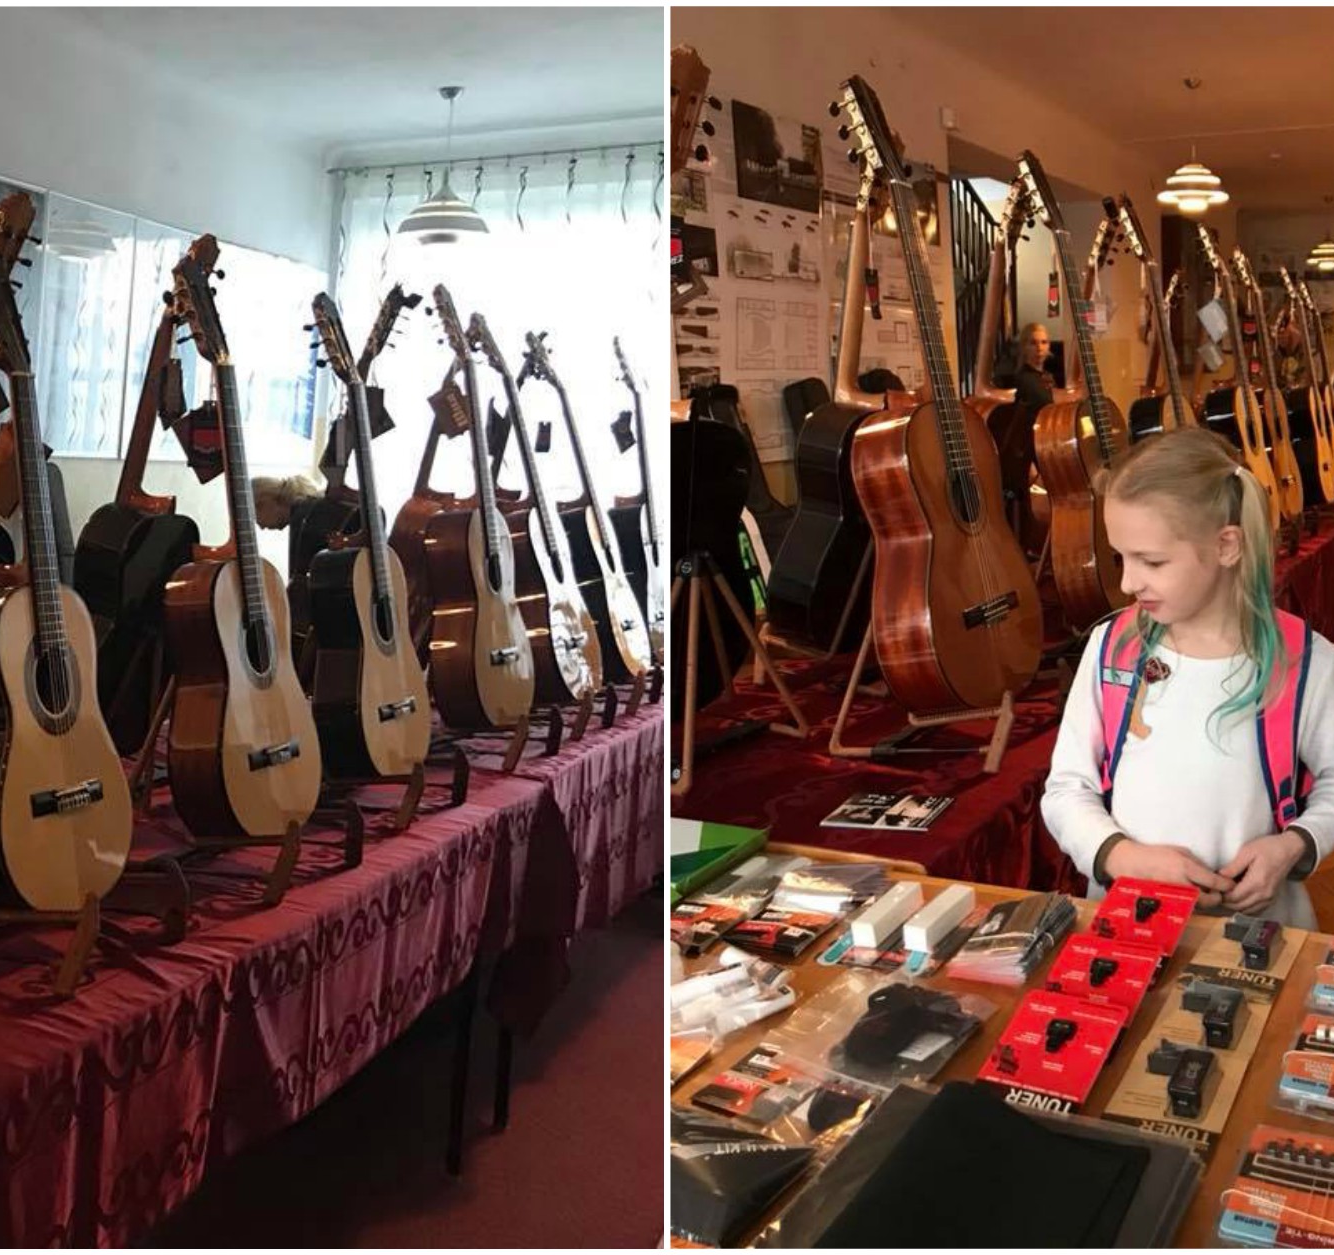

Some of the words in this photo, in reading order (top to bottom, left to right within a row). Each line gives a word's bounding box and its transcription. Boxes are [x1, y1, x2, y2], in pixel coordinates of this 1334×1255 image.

[1217, 968, 1276, 986] TUNER
[1005, 1088, 1072, 1118] TUNER
[1139, 1120, 1211, 1146] TUNER
